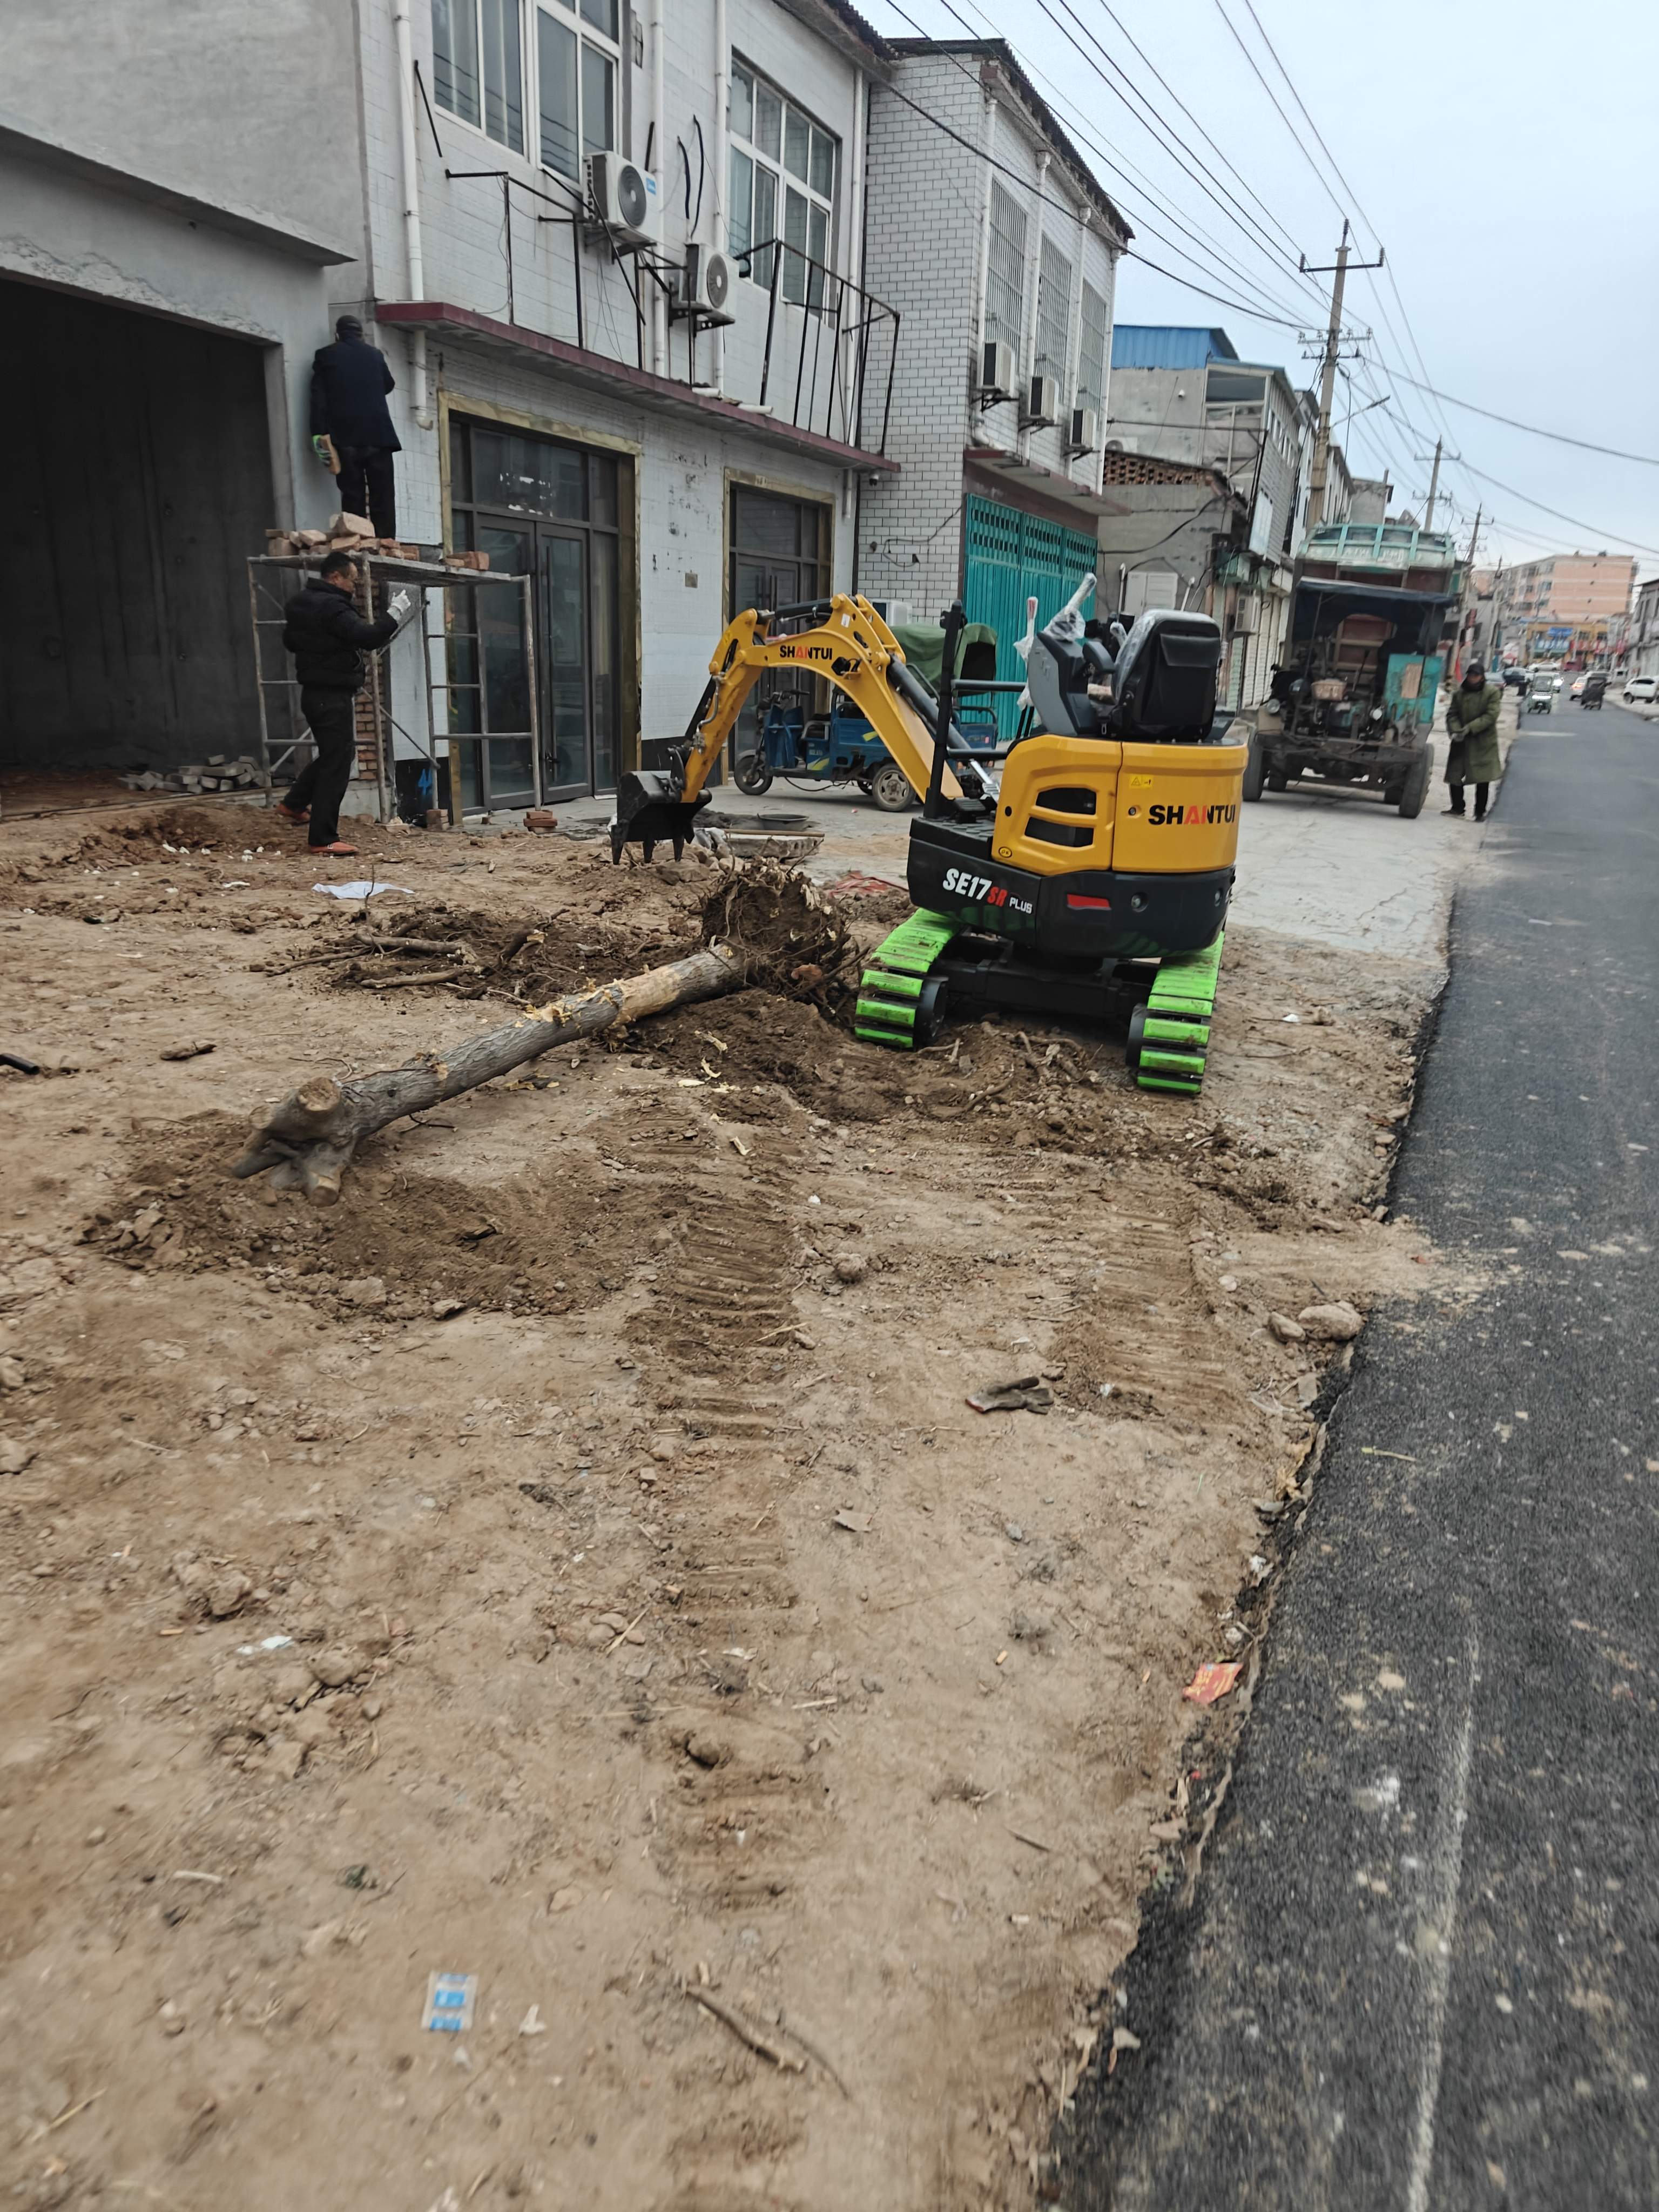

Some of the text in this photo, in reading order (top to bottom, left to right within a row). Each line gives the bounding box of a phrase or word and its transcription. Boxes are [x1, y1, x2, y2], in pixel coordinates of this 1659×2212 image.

[780, 645, 833, 660] SHANTUI
[1148, 804, 1236, 826] SHANTUI
[1009, 896, 1033, 914] PLUS
